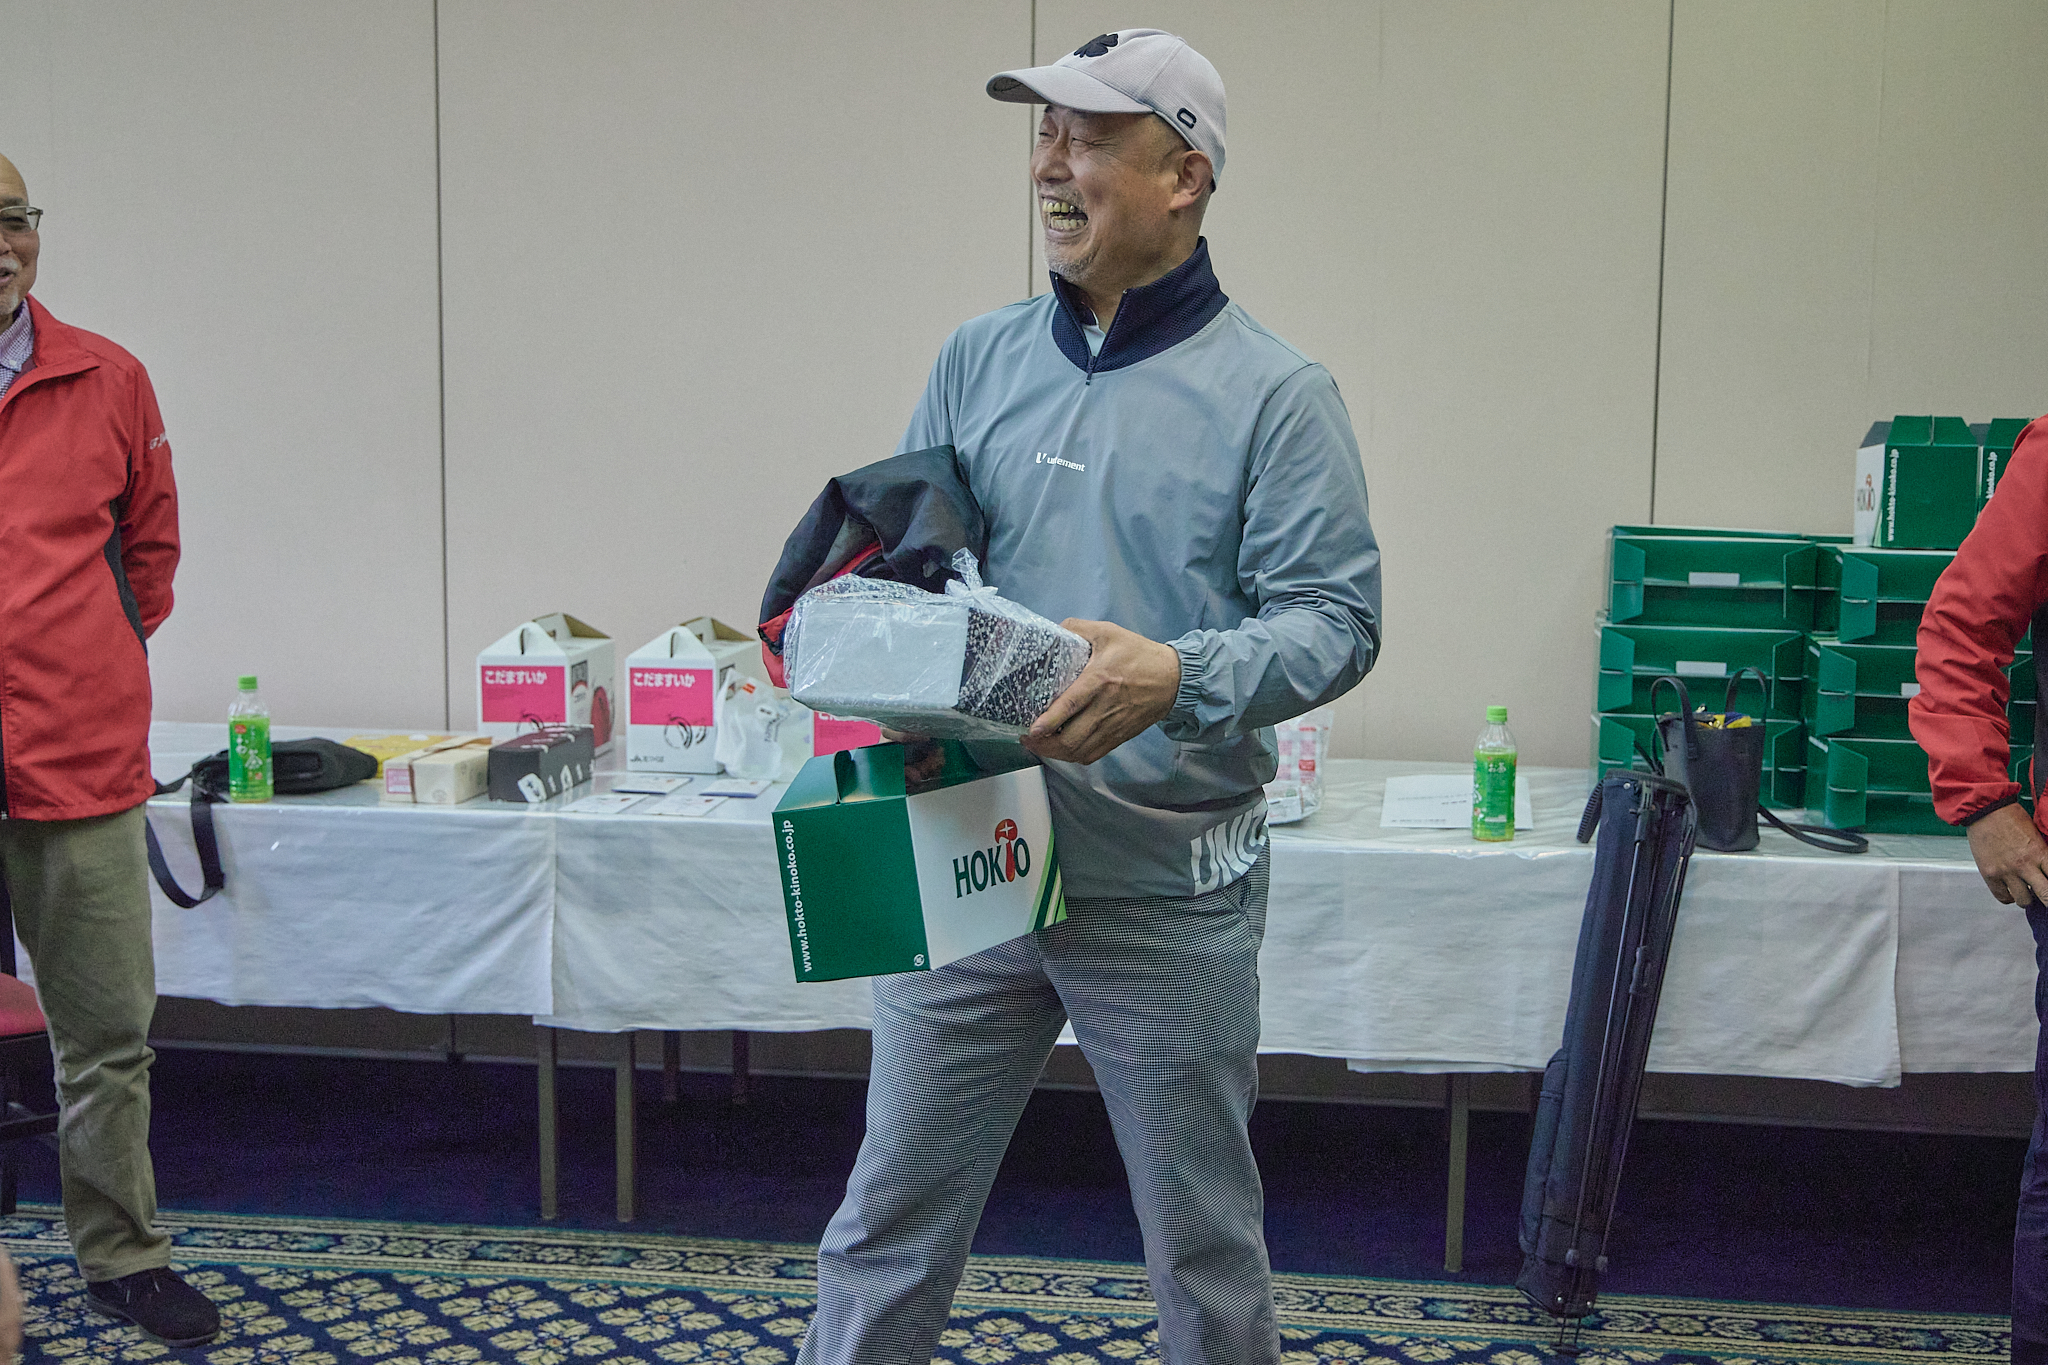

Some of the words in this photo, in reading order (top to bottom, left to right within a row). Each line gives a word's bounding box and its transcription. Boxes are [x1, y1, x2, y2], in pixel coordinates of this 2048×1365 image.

[484, 670, 547, 685] こだますいか
[633, 672, 695, 688] こだますいか
[1488, 762, 1507, 773] お茶
[782, 819, 813, 973] www.hokto-kinoko.co.jp
